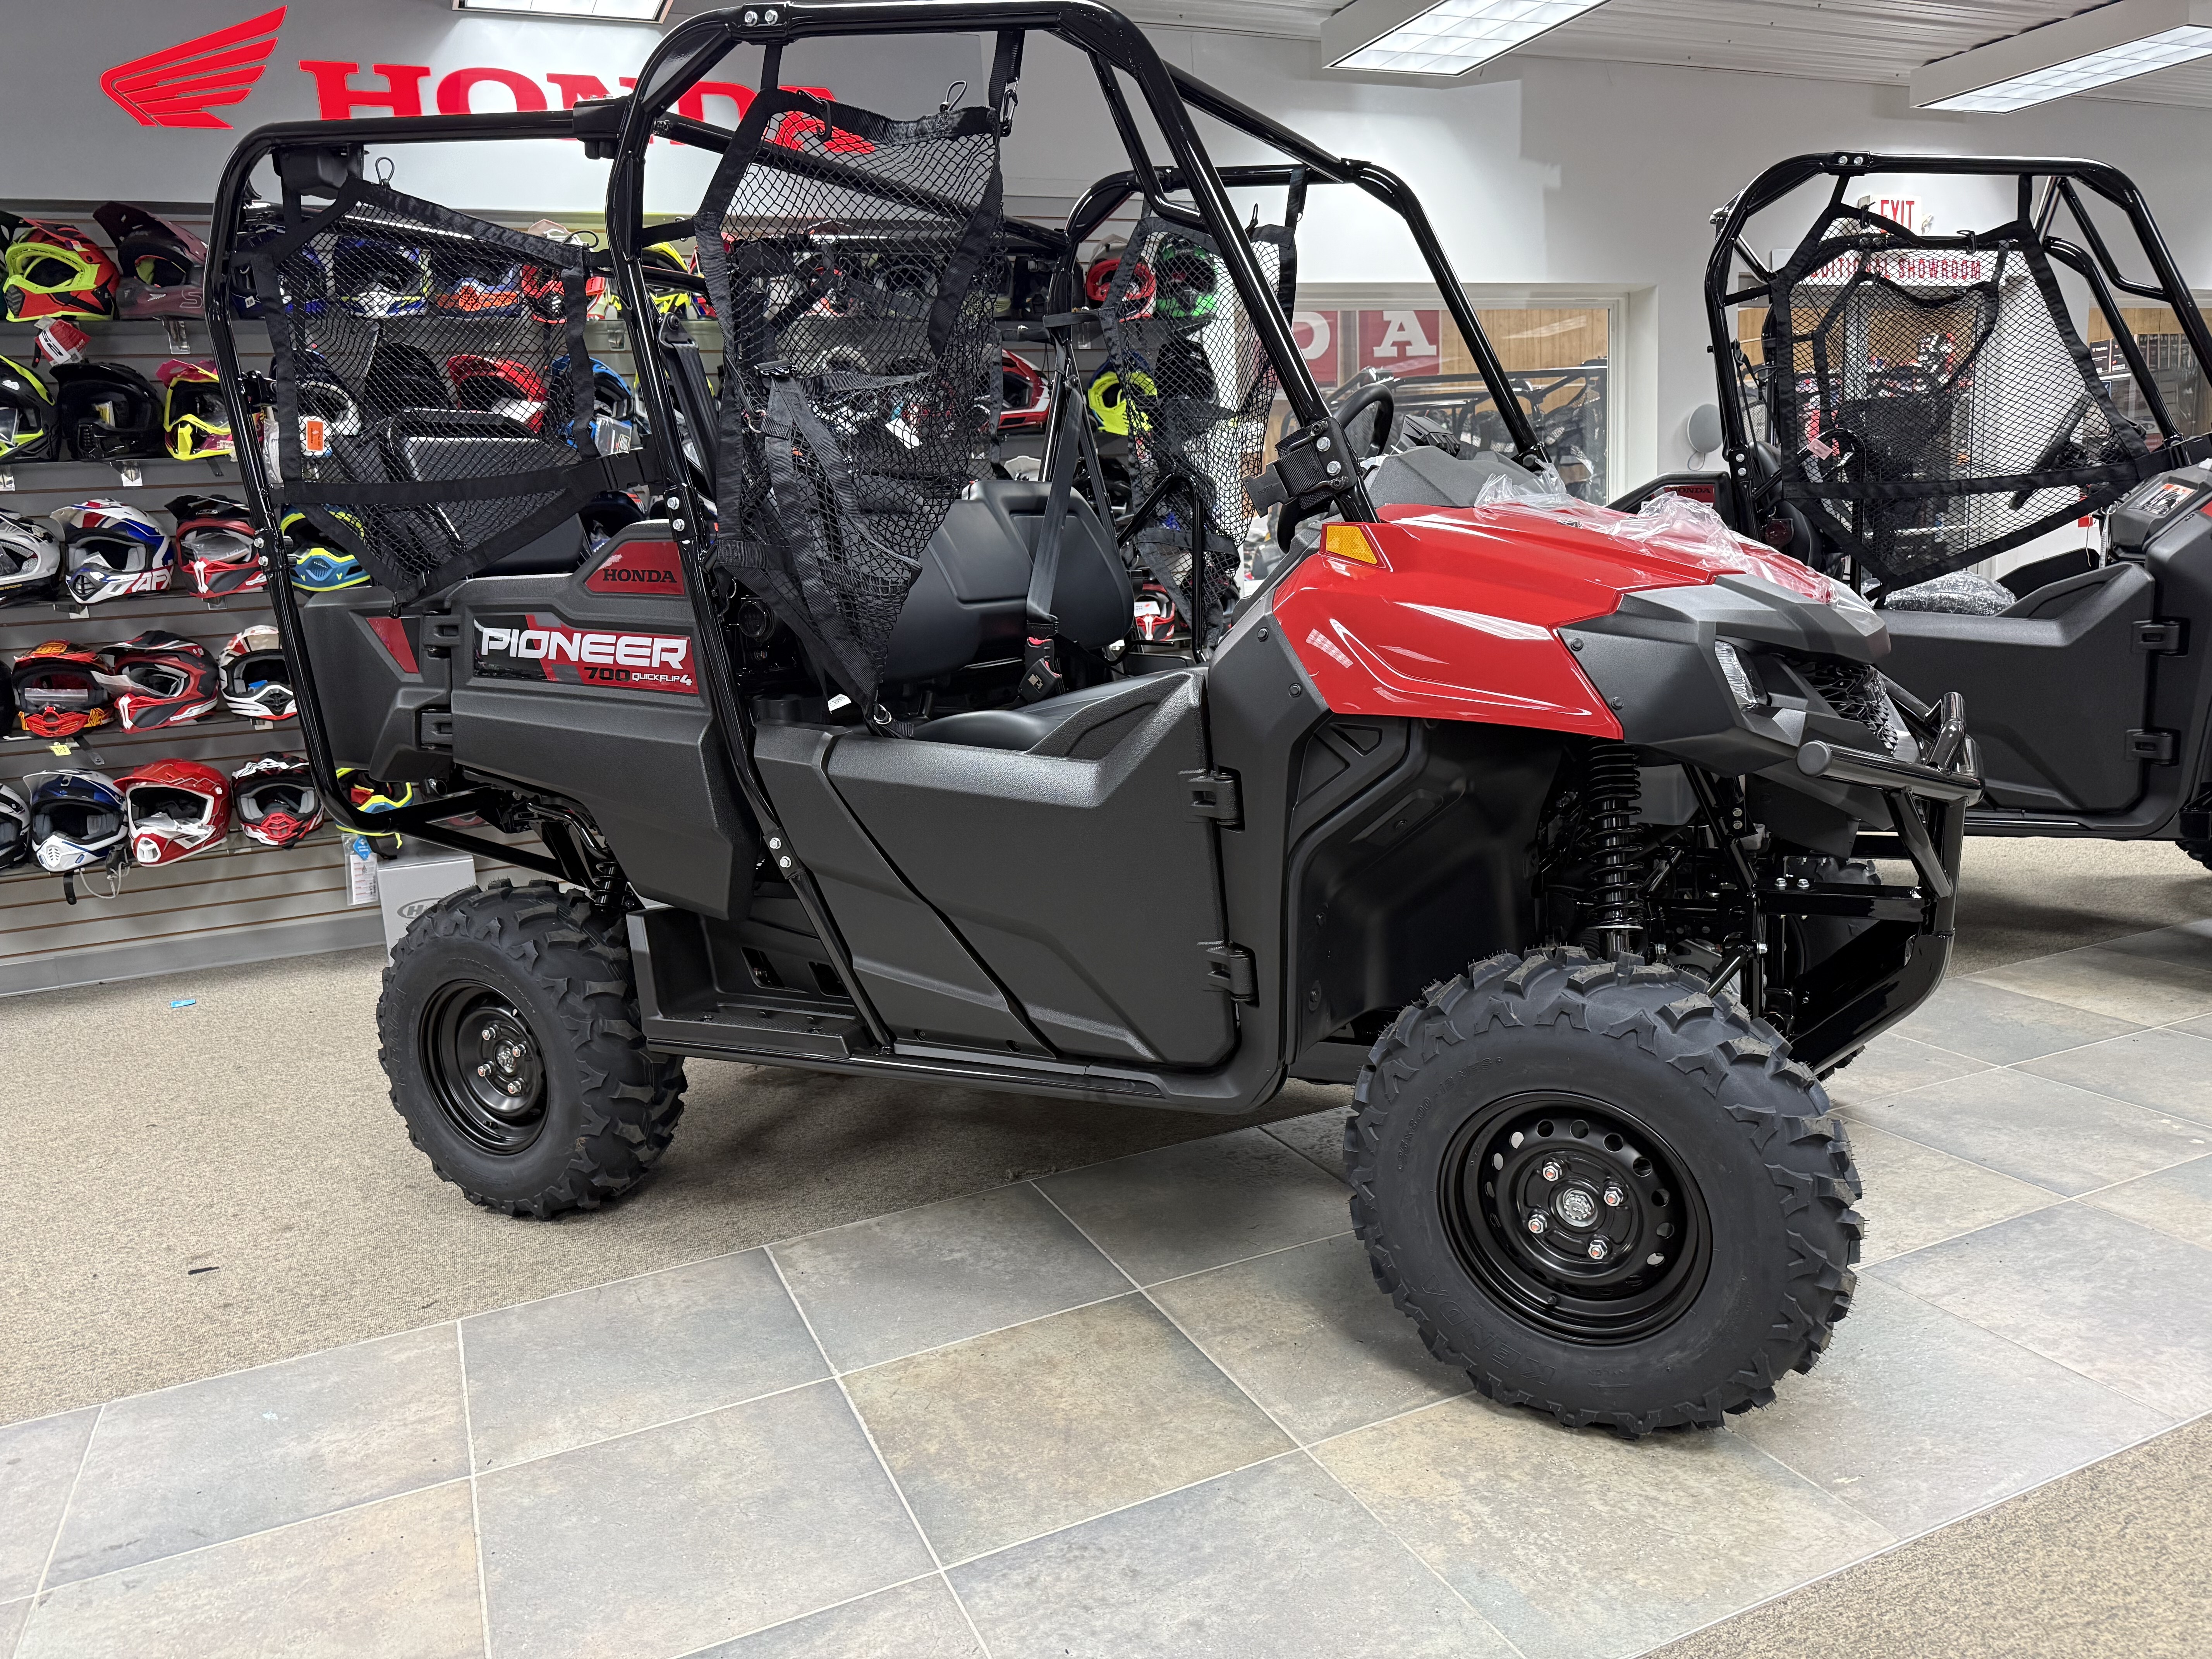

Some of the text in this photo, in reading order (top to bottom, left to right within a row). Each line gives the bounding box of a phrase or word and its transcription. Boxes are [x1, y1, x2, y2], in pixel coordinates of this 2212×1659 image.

[1881, 200, 1915, 233] EXIT
[1899, 258, 1980, 280] SHOWROOM
[603, 568, 677, 583] HONDA
[481, 627, 687, 670] PIONEER
[584, 666, 630, 681] 700
[1420, 1274, 1556, 1386] KENDA
